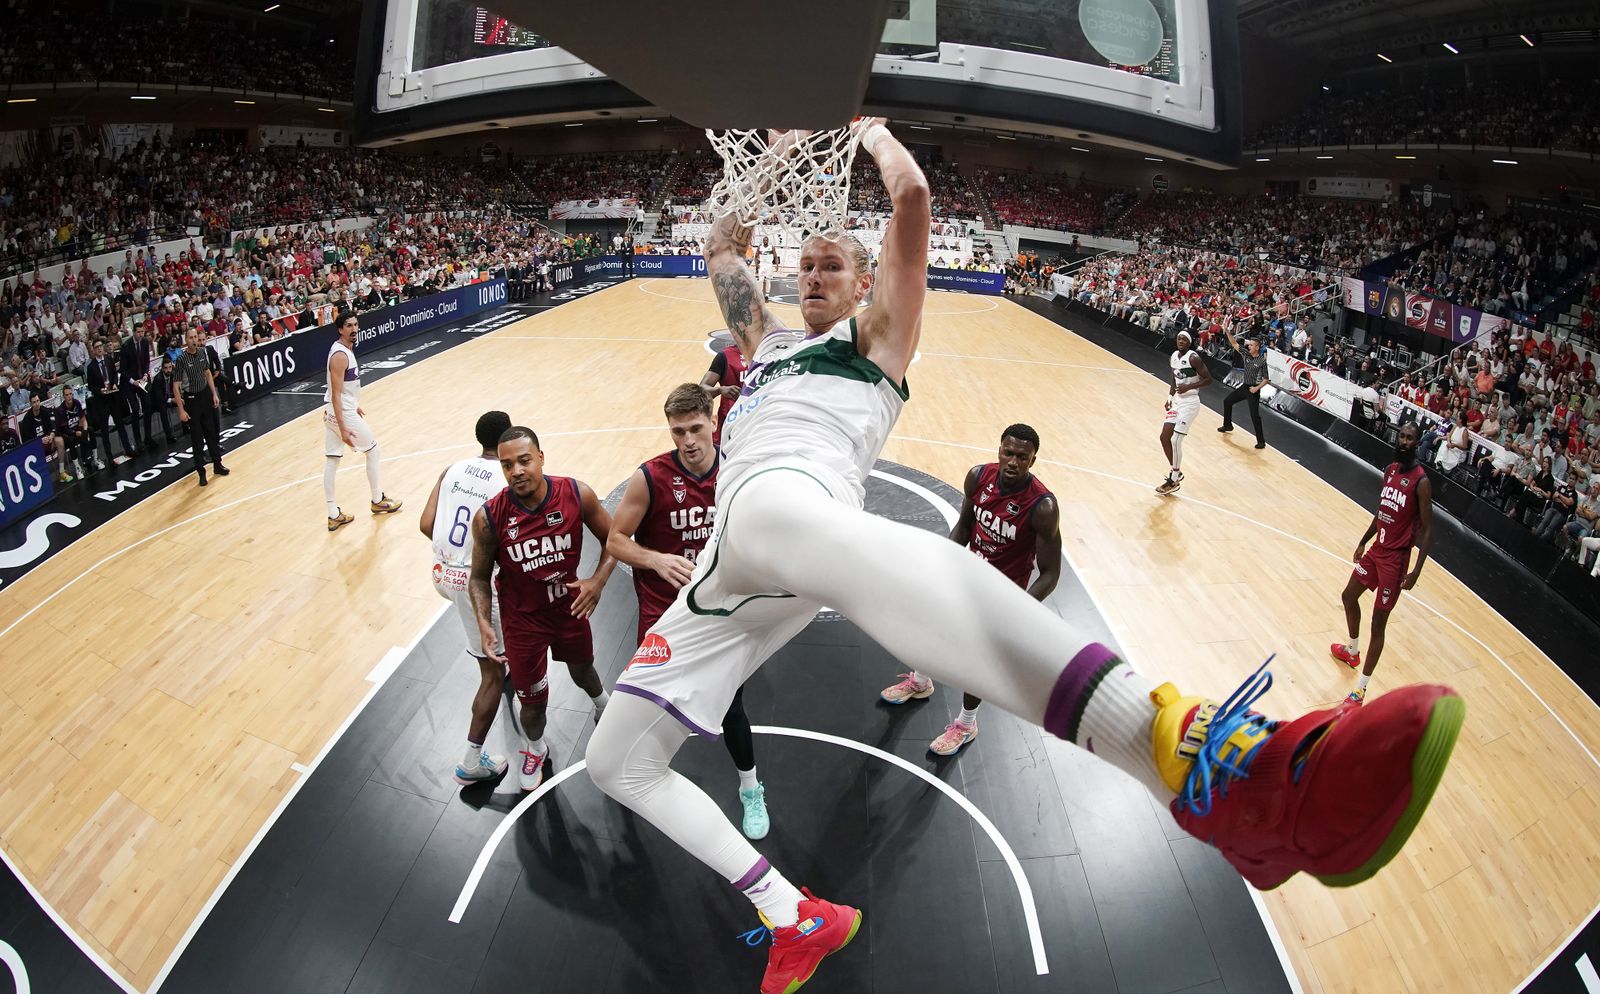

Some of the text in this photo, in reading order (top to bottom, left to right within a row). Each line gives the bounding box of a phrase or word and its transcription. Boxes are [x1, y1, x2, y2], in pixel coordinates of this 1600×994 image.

[555, 266, 573, 283] IONOS
[640, 261, 662, 269] Cloud
[955, 275, 978, 283] Dominios
[231, 346, 296, 395] IONOS
[378, 319, 395, 336] web
[400, 309, 435, 328] Dominios
[438, 300, 458, 316] Cloud
[478, 282, 506, 306] IONOS
[93, 420, 254, 502] Moviar
[464, 464, 492, 482] TAYLOR
[1380, 486, 1407, 507] UCAM
[449, 505, 471, 548] 6
[670, 506, 717, 530] UCA
[973, 504, 1017, 541] UCAM
[682, 526, 715, 541] MURC
[1379, 527, 1386, 544] 8
[506, 533, 572, 562] UCAM
[521, 552, 565, 573] MURCIA
[445, 568, 468, 579] COSTA
[452, 577, 467, 586] SOL
